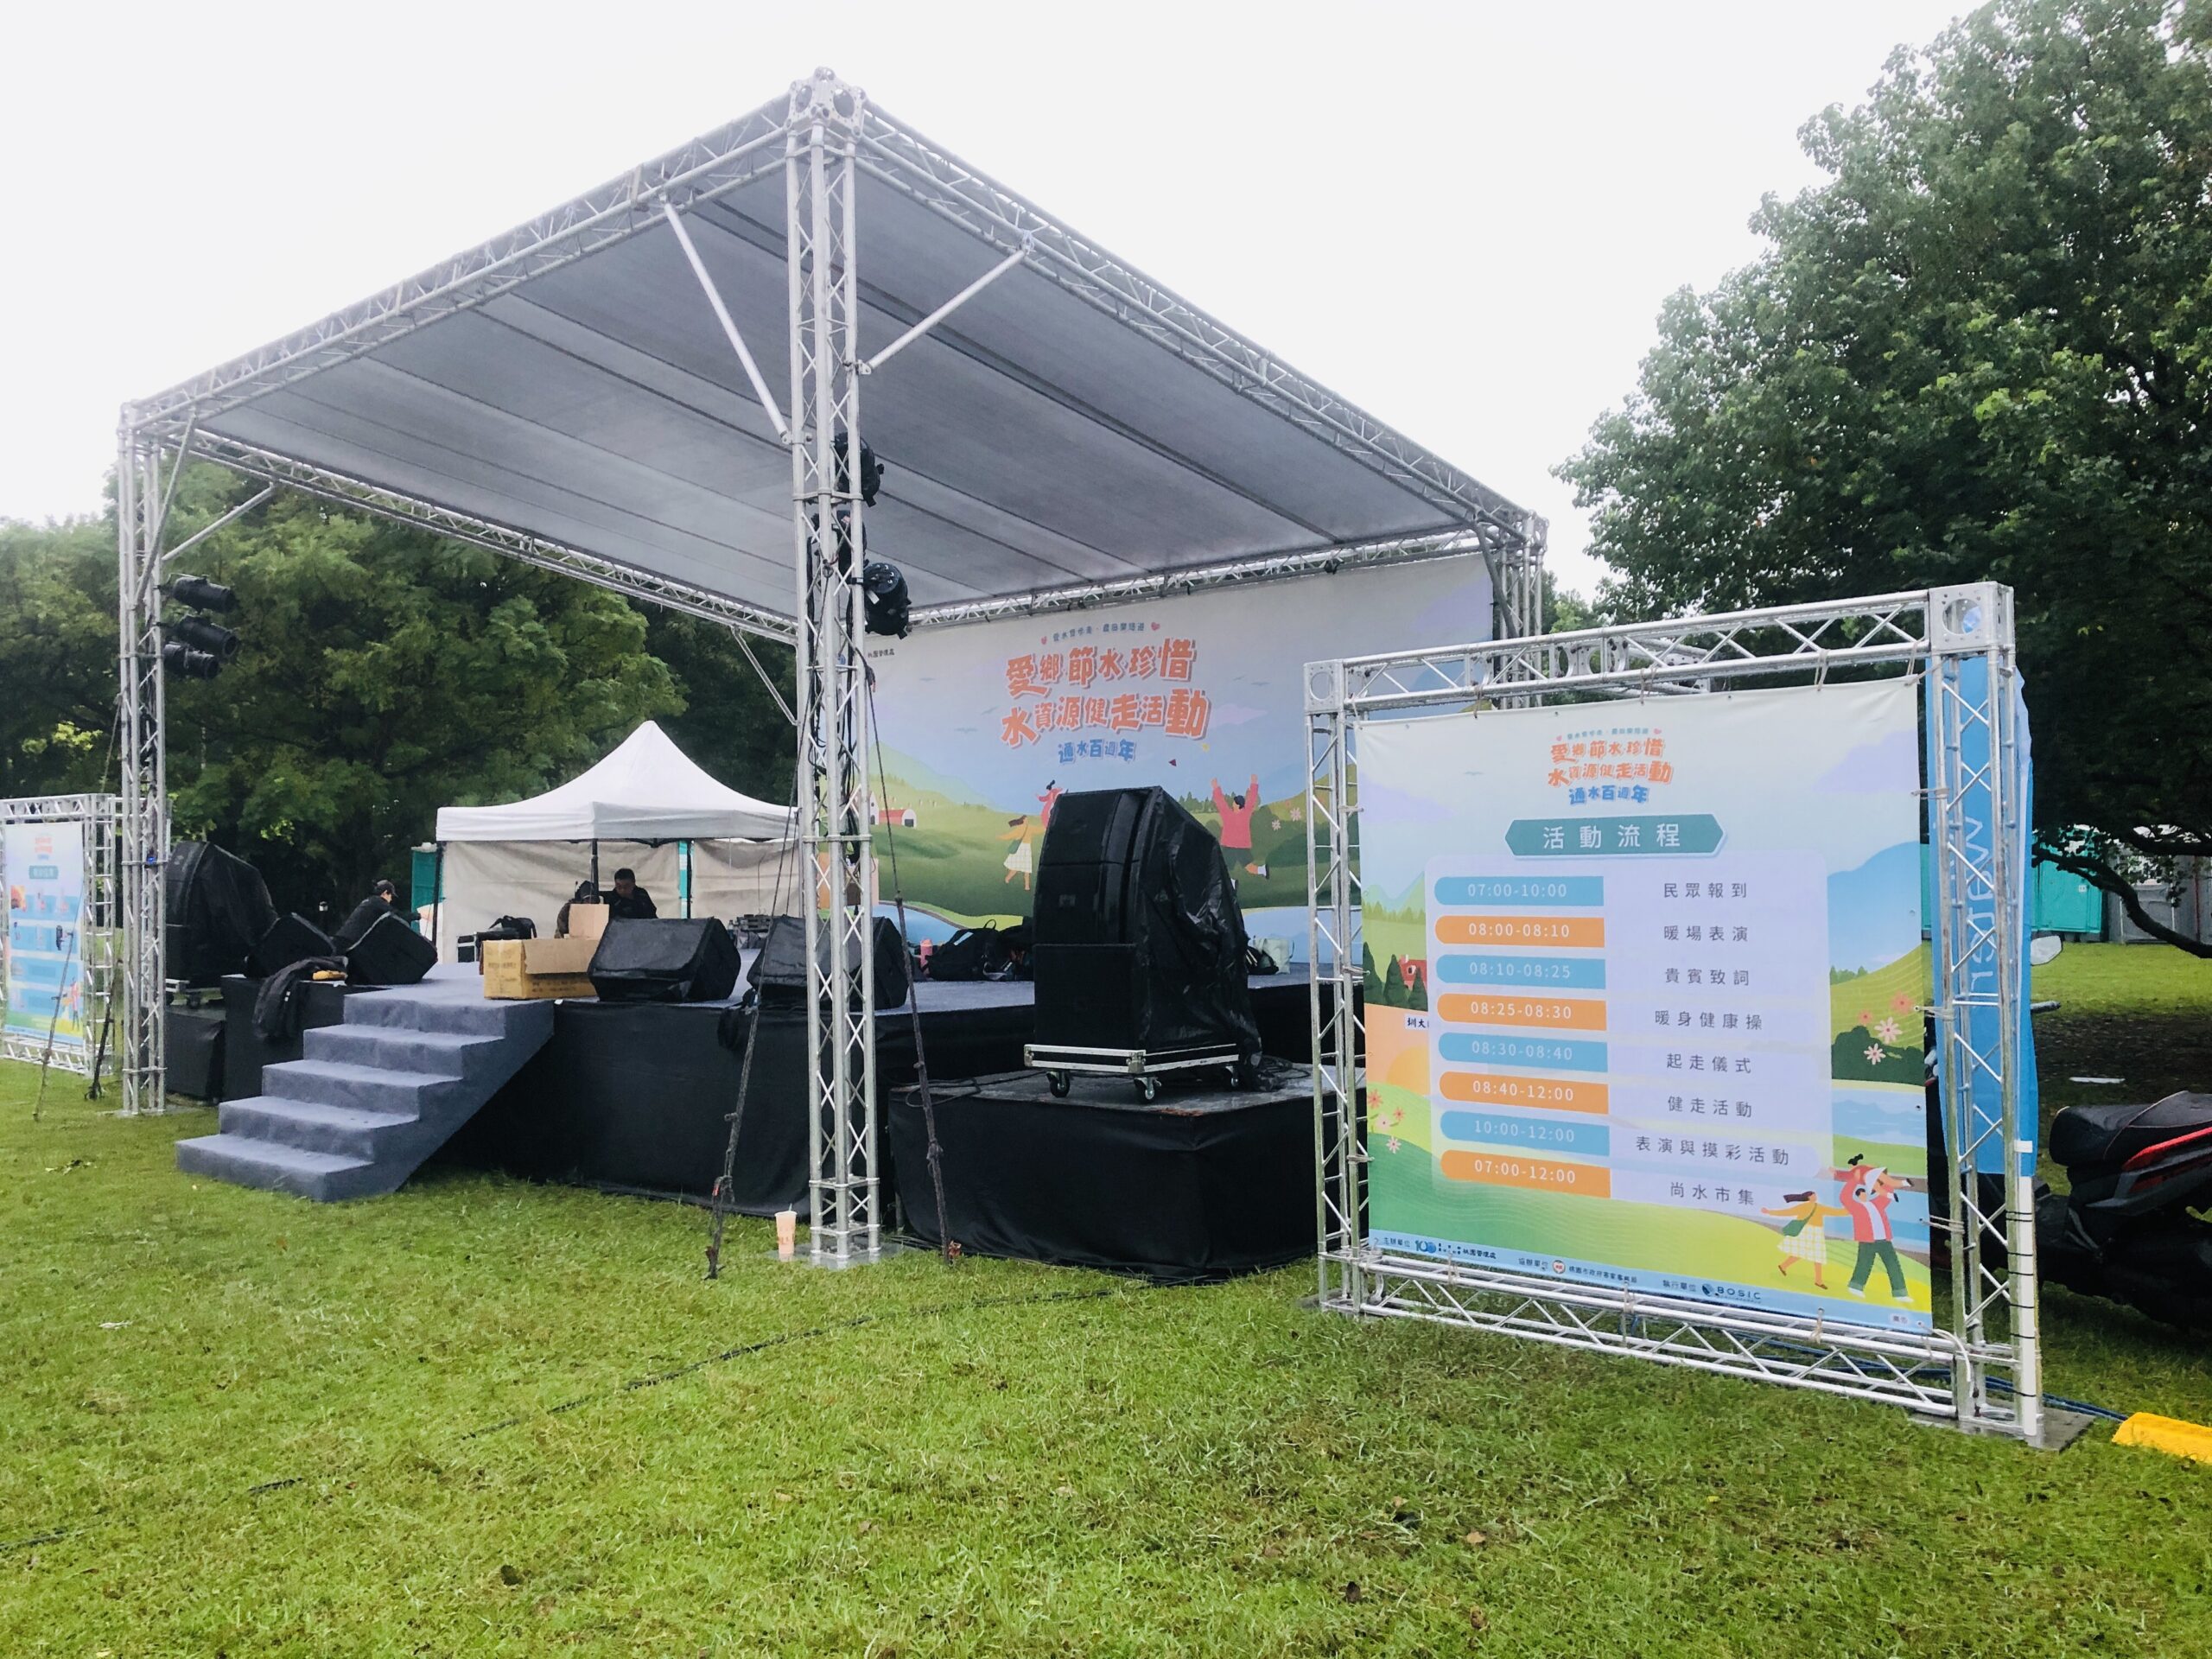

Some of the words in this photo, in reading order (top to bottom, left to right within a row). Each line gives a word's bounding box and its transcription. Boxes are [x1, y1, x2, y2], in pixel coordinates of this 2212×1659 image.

[1006, 638, 1198, 698] 愛鄉節水珍惜
[1001, 689, 1211, 748] 水資源健走活動
[1058, 740, 1136, 764] 通水百週年
[1550, 738, 1665, 765] 愛鄉節水珍惜
[1548, 760, 1674, 787] 水資源健走活動
[1568, 784, 1649, 805] 通水百週年
[1542, 823, 1681, 850] 活動流程
[1467, 883, 1567, 899] 07:00-10:00
[1662, 882, 1747, 899] 民眾報到
[1468, 923, 1570, 939] 08:00-08:10
[1663, 925, 1748, 943] 暖場表演
[1469, 962, 1571, 980] 08:10-08:25
[1664, 968, 1750, 987] 貴賓致詞
[1470, 1001, 1572, 1021] 08:25-08:30
[1655, 1010, 1763, 1030] 暖身健康操
[1471, 1040, 1573, 1062] 08:30-08:40
[1667, 1053, 1751, 1073] 起走儀式
[1472, 1080, 1574, 1103] 08:40-12:00
[1668, 1096, 1752, 1118] 健走活動
[1474, 1121, 1575, 1144] 10:00-12:00
[1636, 1136, 1789, 1166] 表演與摸彩活動
[1474, 1159, 1576, 1185] 07:00-12:00
[1670, 1182, 1754, 1205] 尚水市集
[1717, 1286, 1762, 1300] BOSIC
